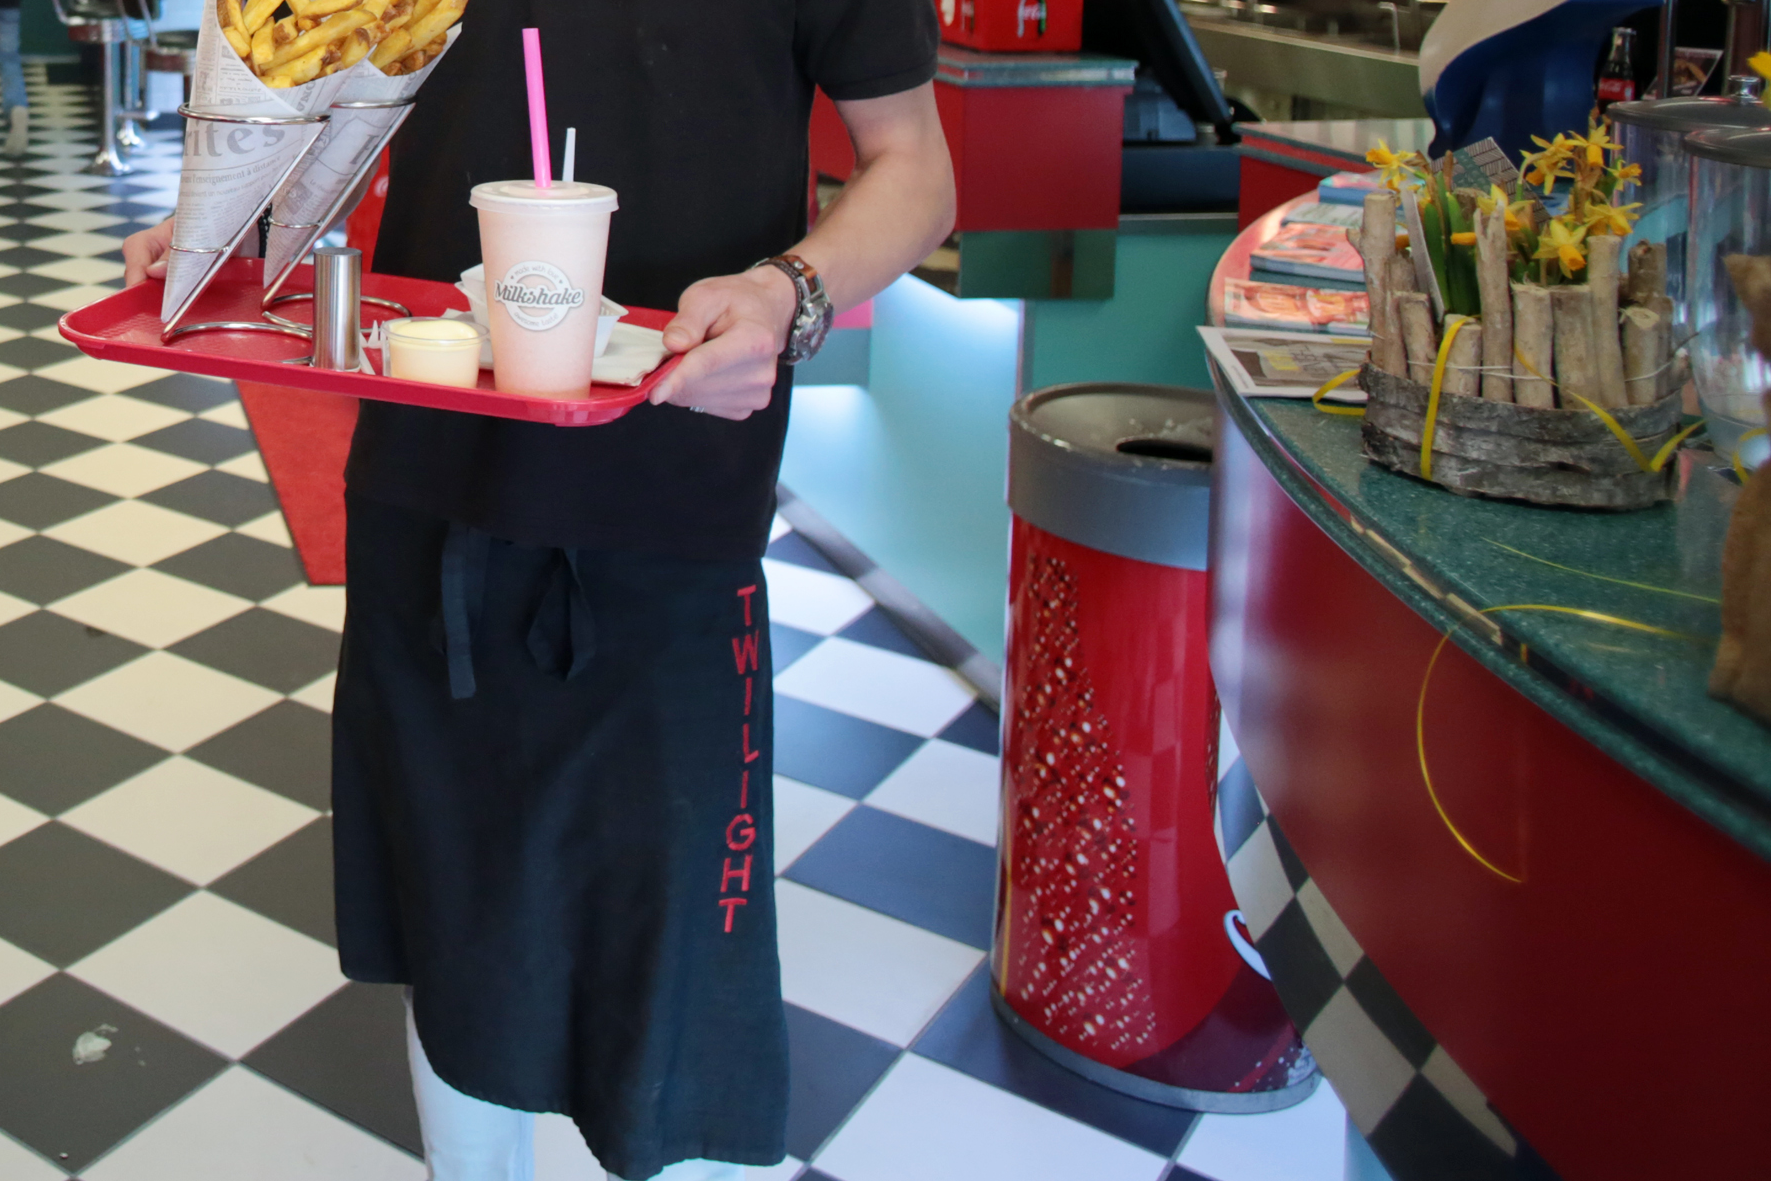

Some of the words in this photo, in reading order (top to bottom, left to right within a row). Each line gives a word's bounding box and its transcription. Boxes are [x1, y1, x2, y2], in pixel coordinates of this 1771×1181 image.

[514, 265, 530, 276] made
[531, 265, 546, 273] with
[496, 282, 582, 306] Milkshake
[718, 583, 760, 934] TWILIGHT
